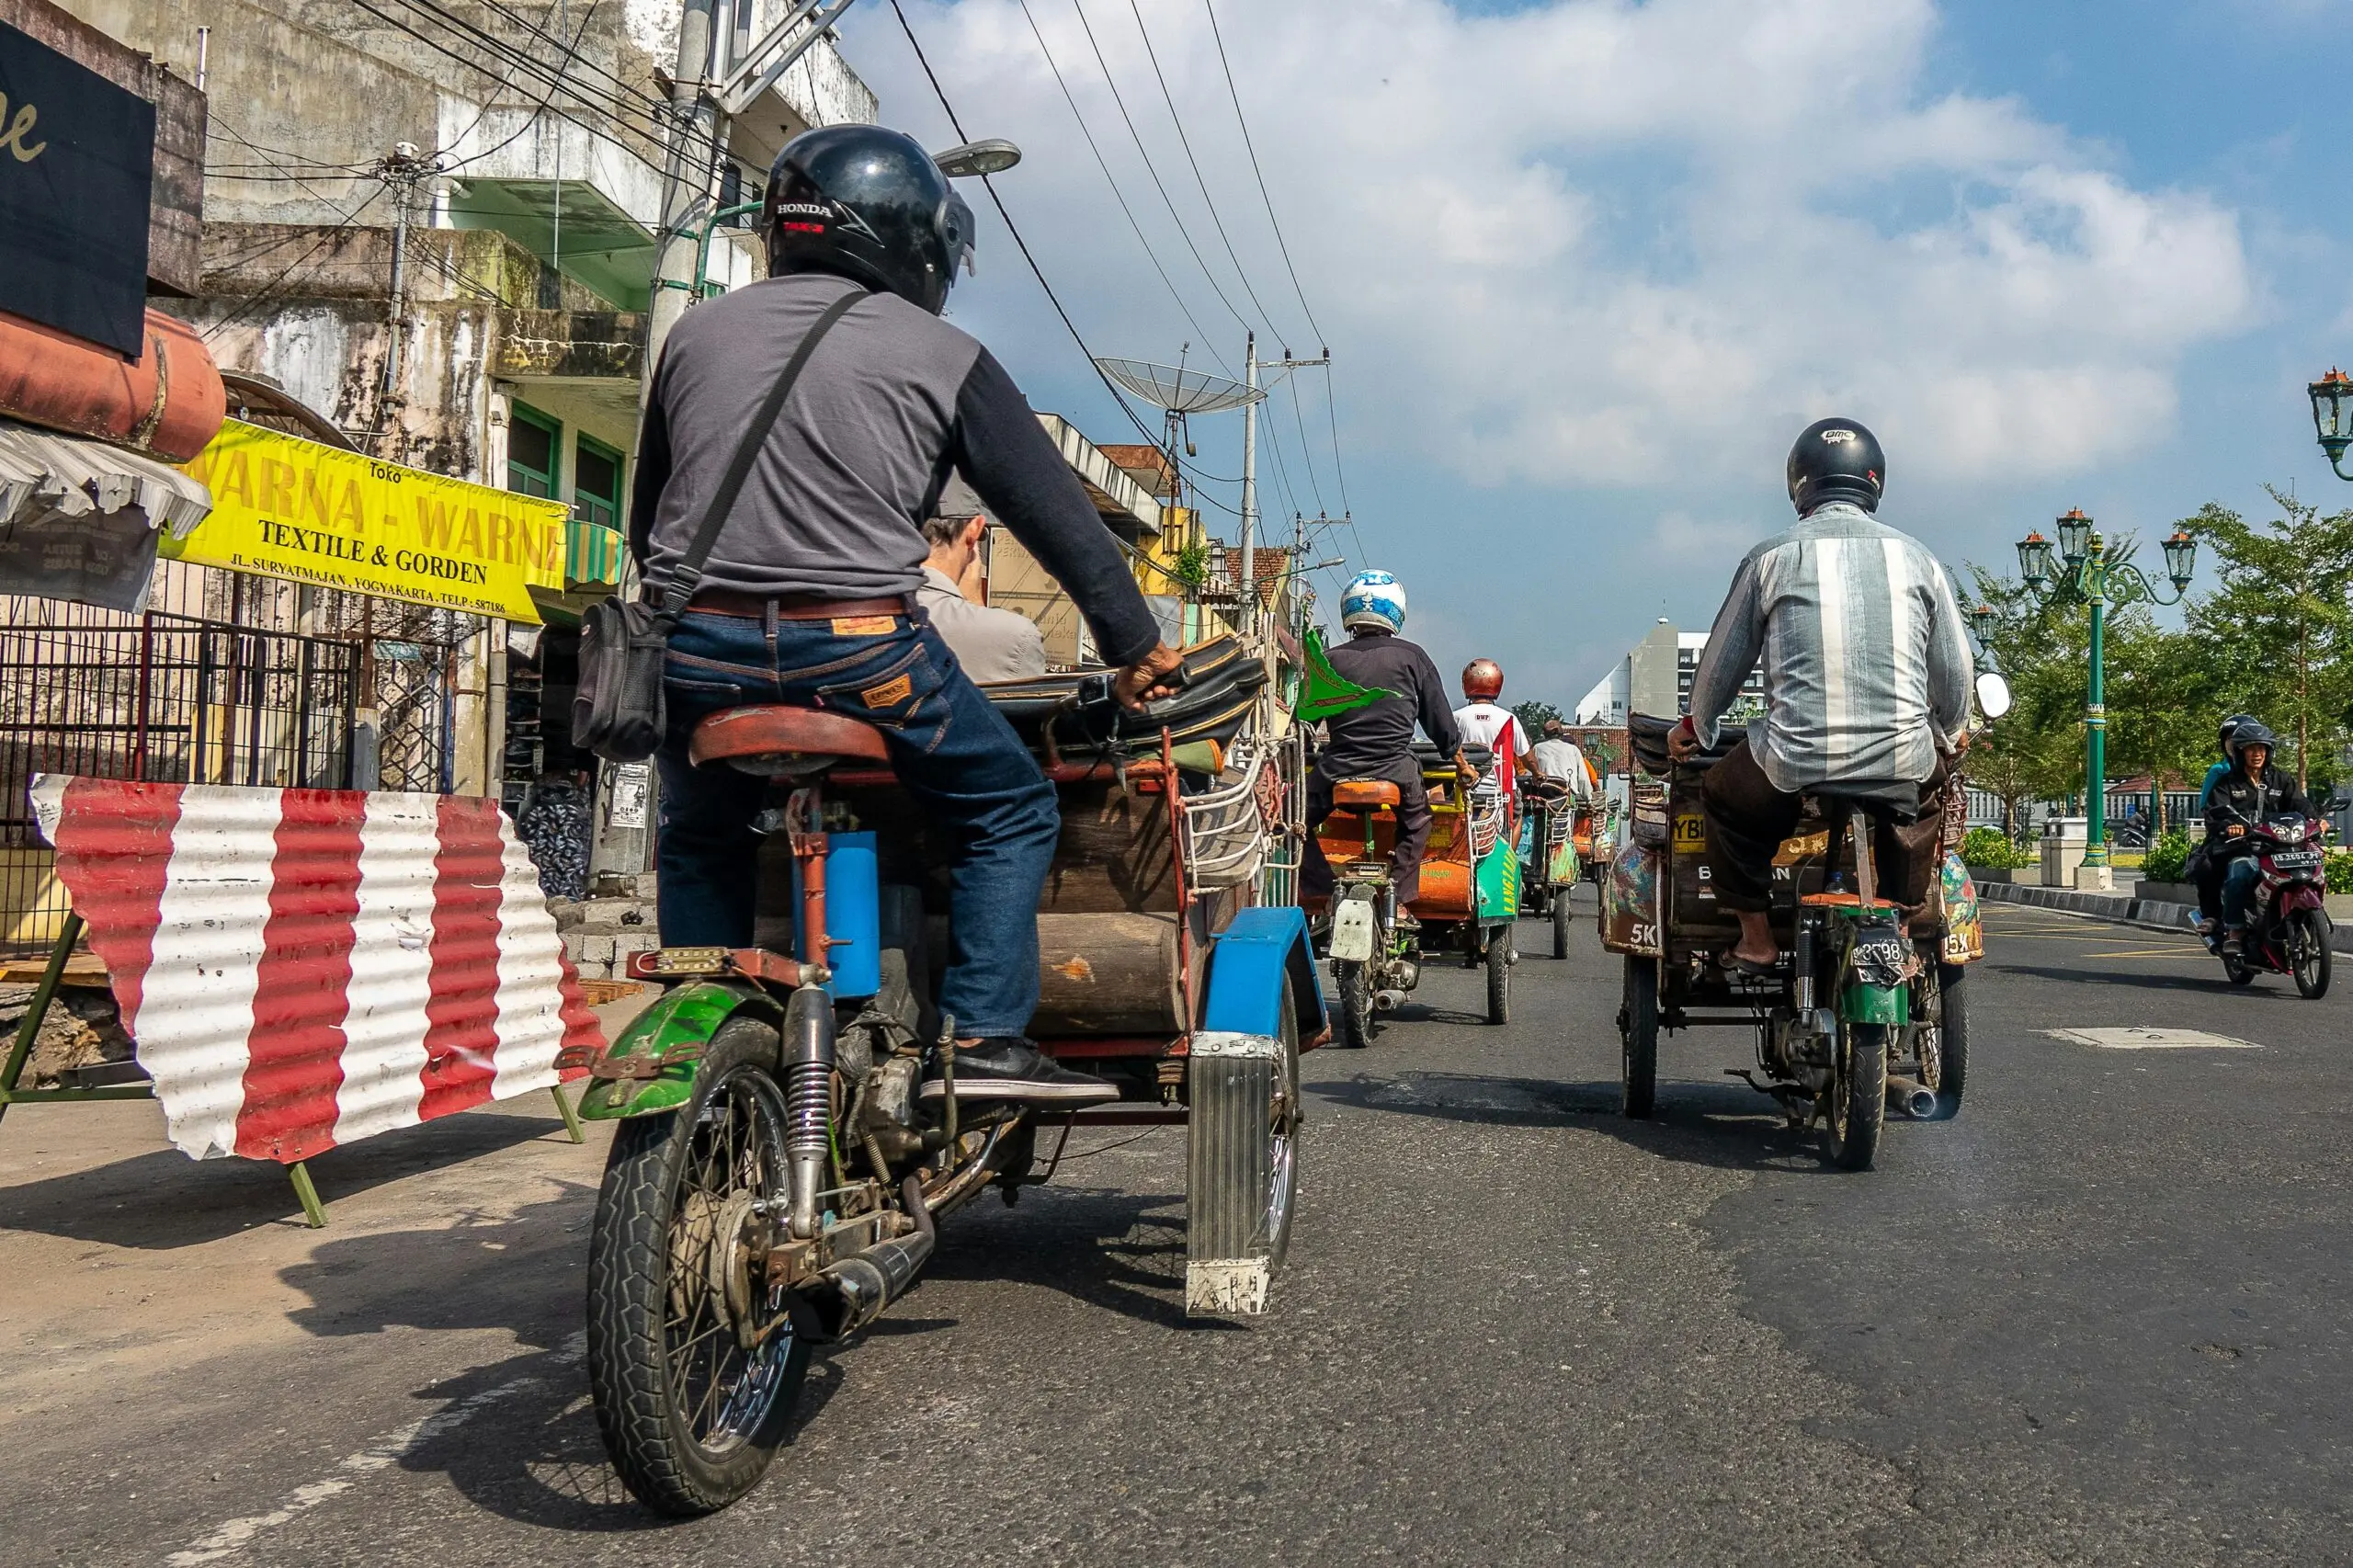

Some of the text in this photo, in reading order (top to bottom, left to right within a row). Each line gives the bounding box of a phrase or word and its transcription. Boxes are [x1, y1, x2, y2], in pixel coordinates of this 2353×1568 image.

[777, 203, 834, 218] HONDA
[369, 461, 402, 483] Toko
[258, 519, 487, 585] TEXTILE & GORDEN
[231, 553, 251, 568] JL.
[475, 599, 506, 614] 587186
[1631, 923, 1656, 946] 5K
